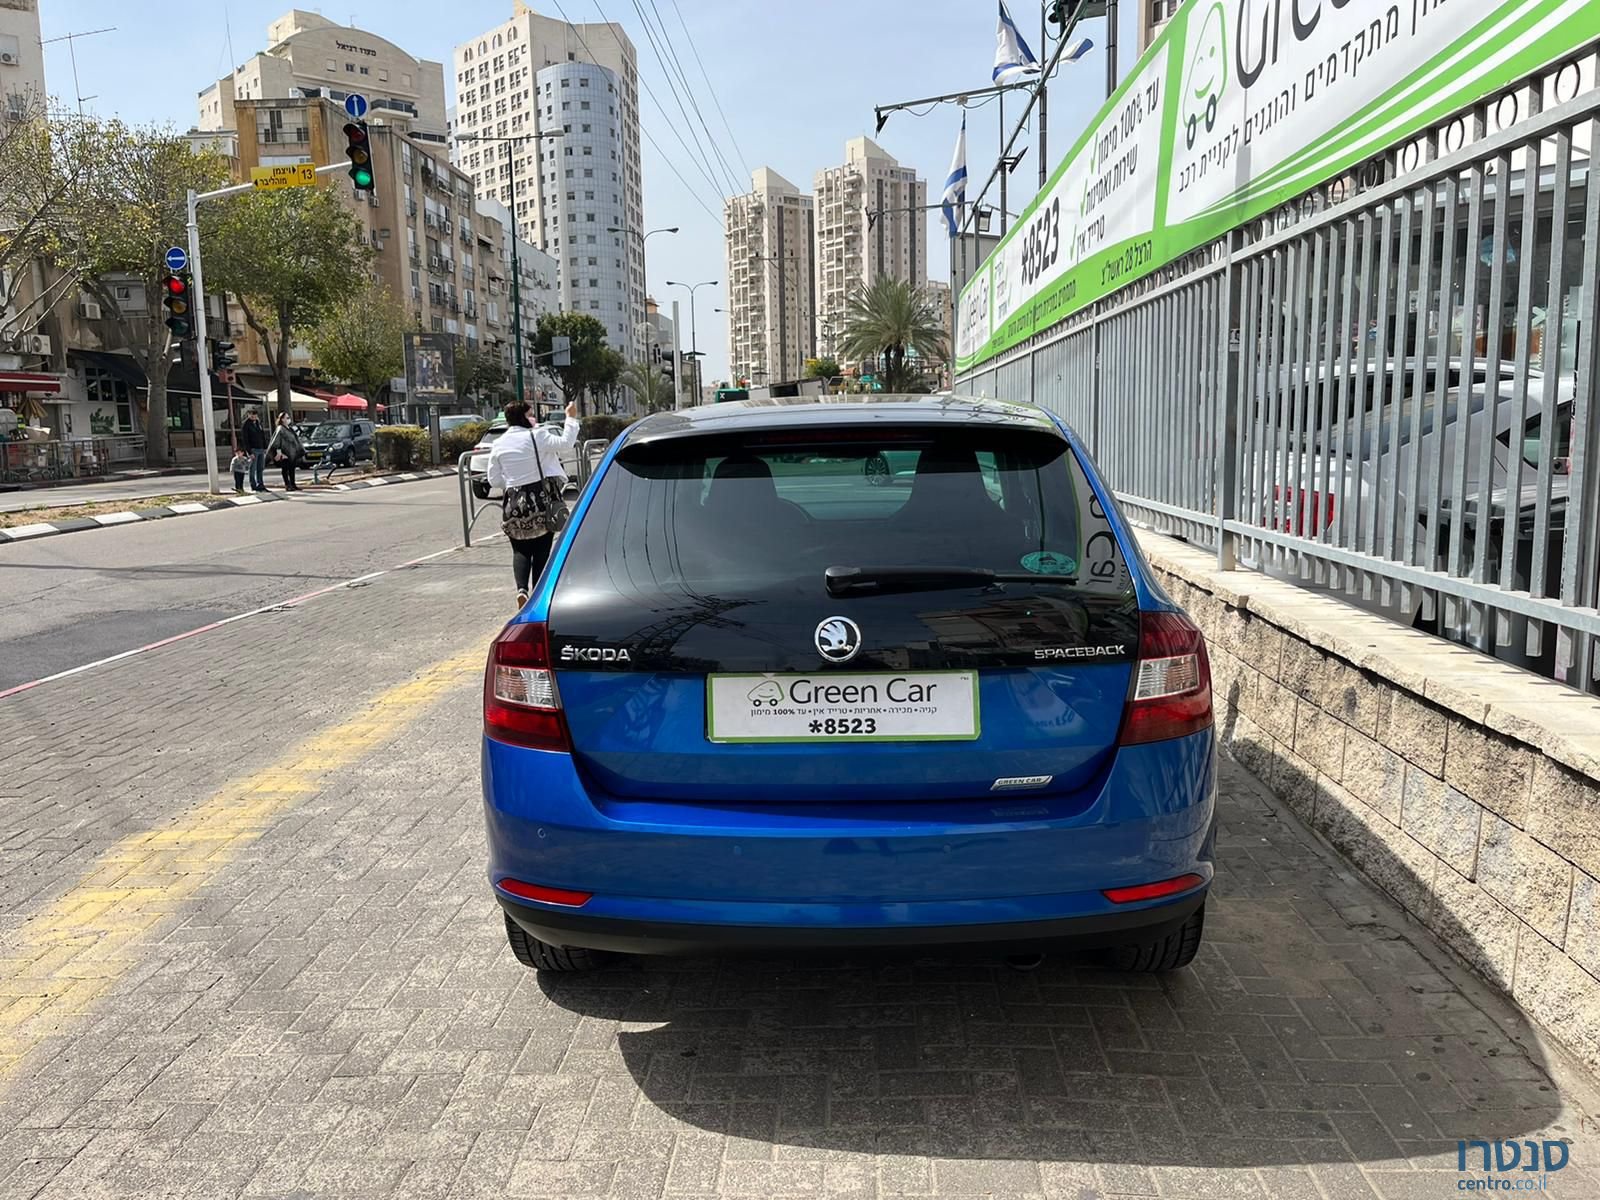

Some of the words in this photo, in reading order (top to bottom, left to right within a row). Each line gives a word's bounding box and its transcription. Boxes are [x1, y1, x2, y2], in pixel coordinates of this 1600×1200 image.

[1305, 5, 1399, 102] מתקדמים
[1146, 77, 1160, 115] עד
[1120, 93, 1143, 144] 100%
[1244, 83, 1297, 146] והוגנים
[1097, 124, 1118, 175] מימון
[1199, 123, 1240, 178] לקניית
[272, 167, 291, 177] ויצמן
[301, 169, 313, 180] 13
[1112, 144, 1138, 191] שירות
[1178, 160, 1197, 193] רכב
[1085, 168, 1112, 216] ואמינות
[1087, 214, 1105, 250] טרייד
[1076, 229, 1086, 265] אין
[1125, 246, 1134, 273] 28
[1134, 239, 1152, 267] הרצל
[560, 644, 631, 662] ŠKODA
[1034, 644, 1126, 660] SPACEBACK
[790, 679, 878, 704] Green
[886, 677, 937, 703] Car
[750, 708, 771, 717] מימון
[773, 708, 795, 716] 100%
[813, 708, 825, 716] אין
[827, 707, 848, 715] טרייד
[919, 706, 937, 715] קניה
[1025, 777, 1042, 785] CAR
